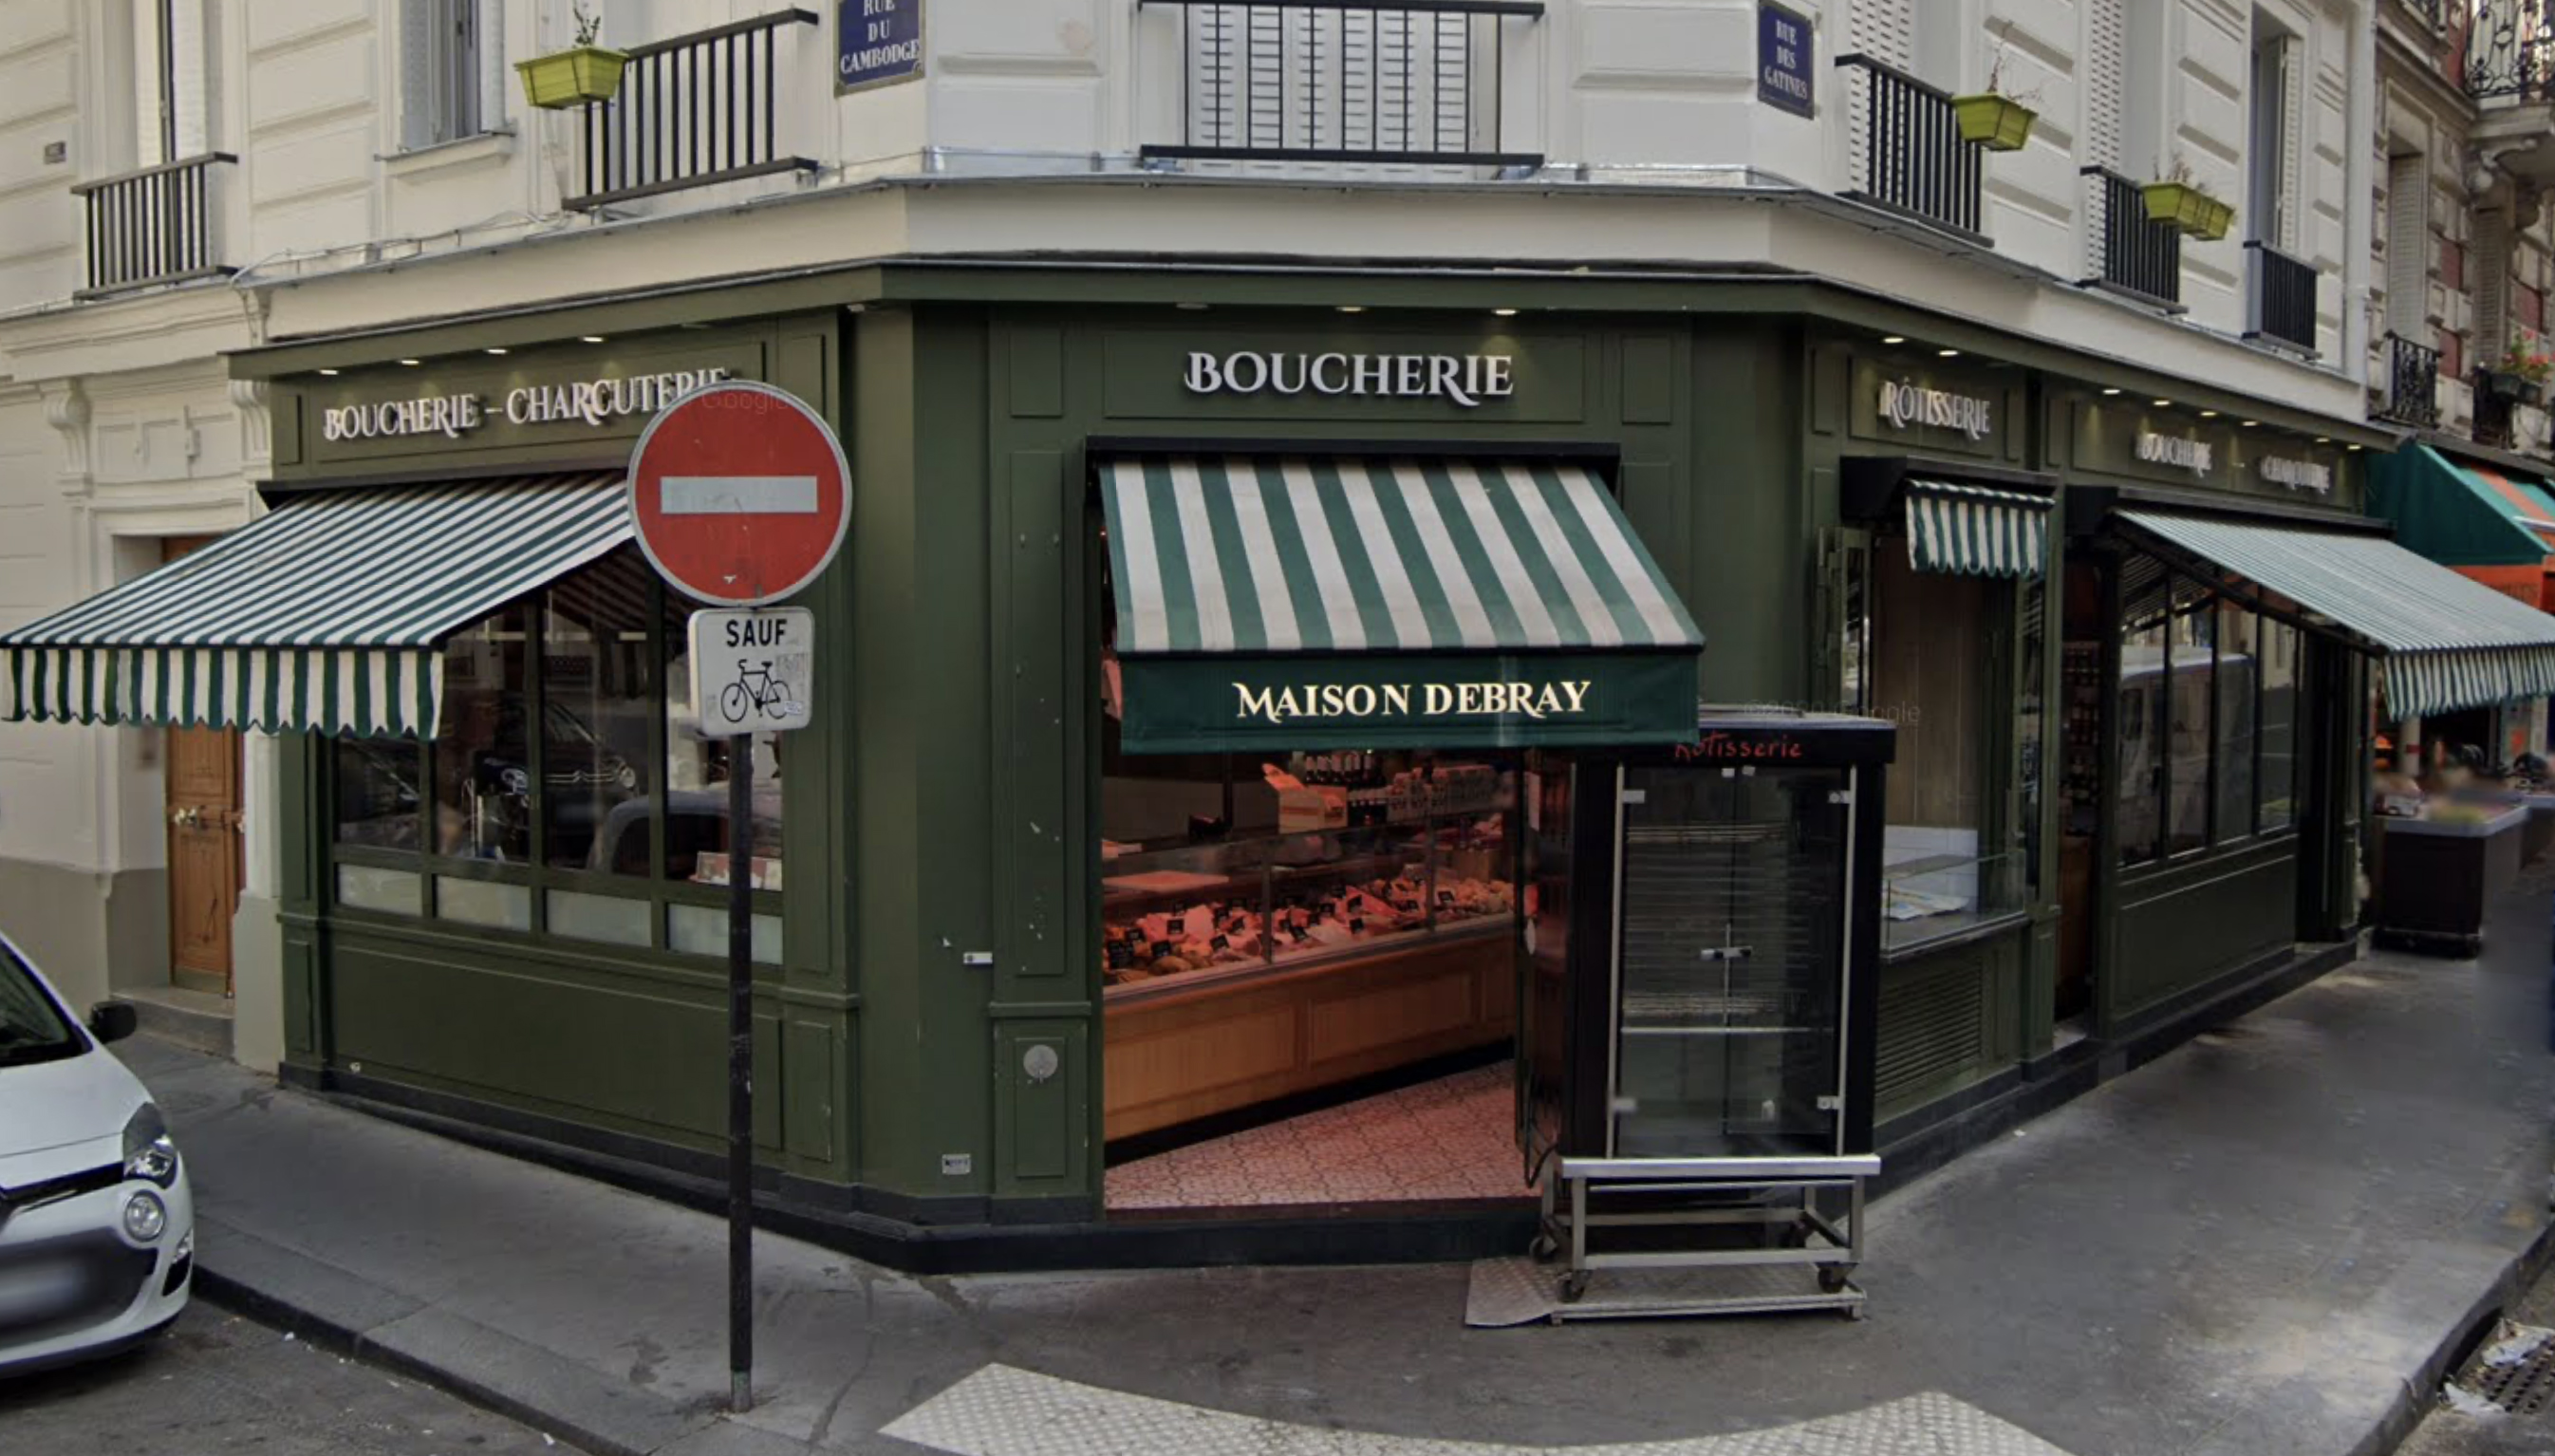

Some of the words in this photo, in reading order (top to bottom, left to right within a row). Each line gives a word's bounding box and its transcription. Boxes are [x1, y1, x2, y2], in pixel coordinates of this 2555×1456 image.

[863, 0, 895, 16] RUE
[867, 20, 889, 42] DU
[1776, 19, 1797, 46] RUE
[840, 39, 920, 74] CAMBODGE
[1776, 45, 1797, 69] DES
[1184, 351, 1514, 406] BOUCHERIE
[323, 393, 477, 441] BOUCHERIE
[1878, 376, 1991, 440] RÔTISSERIE
[726, 618, 787, 647] SAUF
[1232, 682, 1411, 723] MAISON
[1423, 681, 1591, 719] DEBRAY
